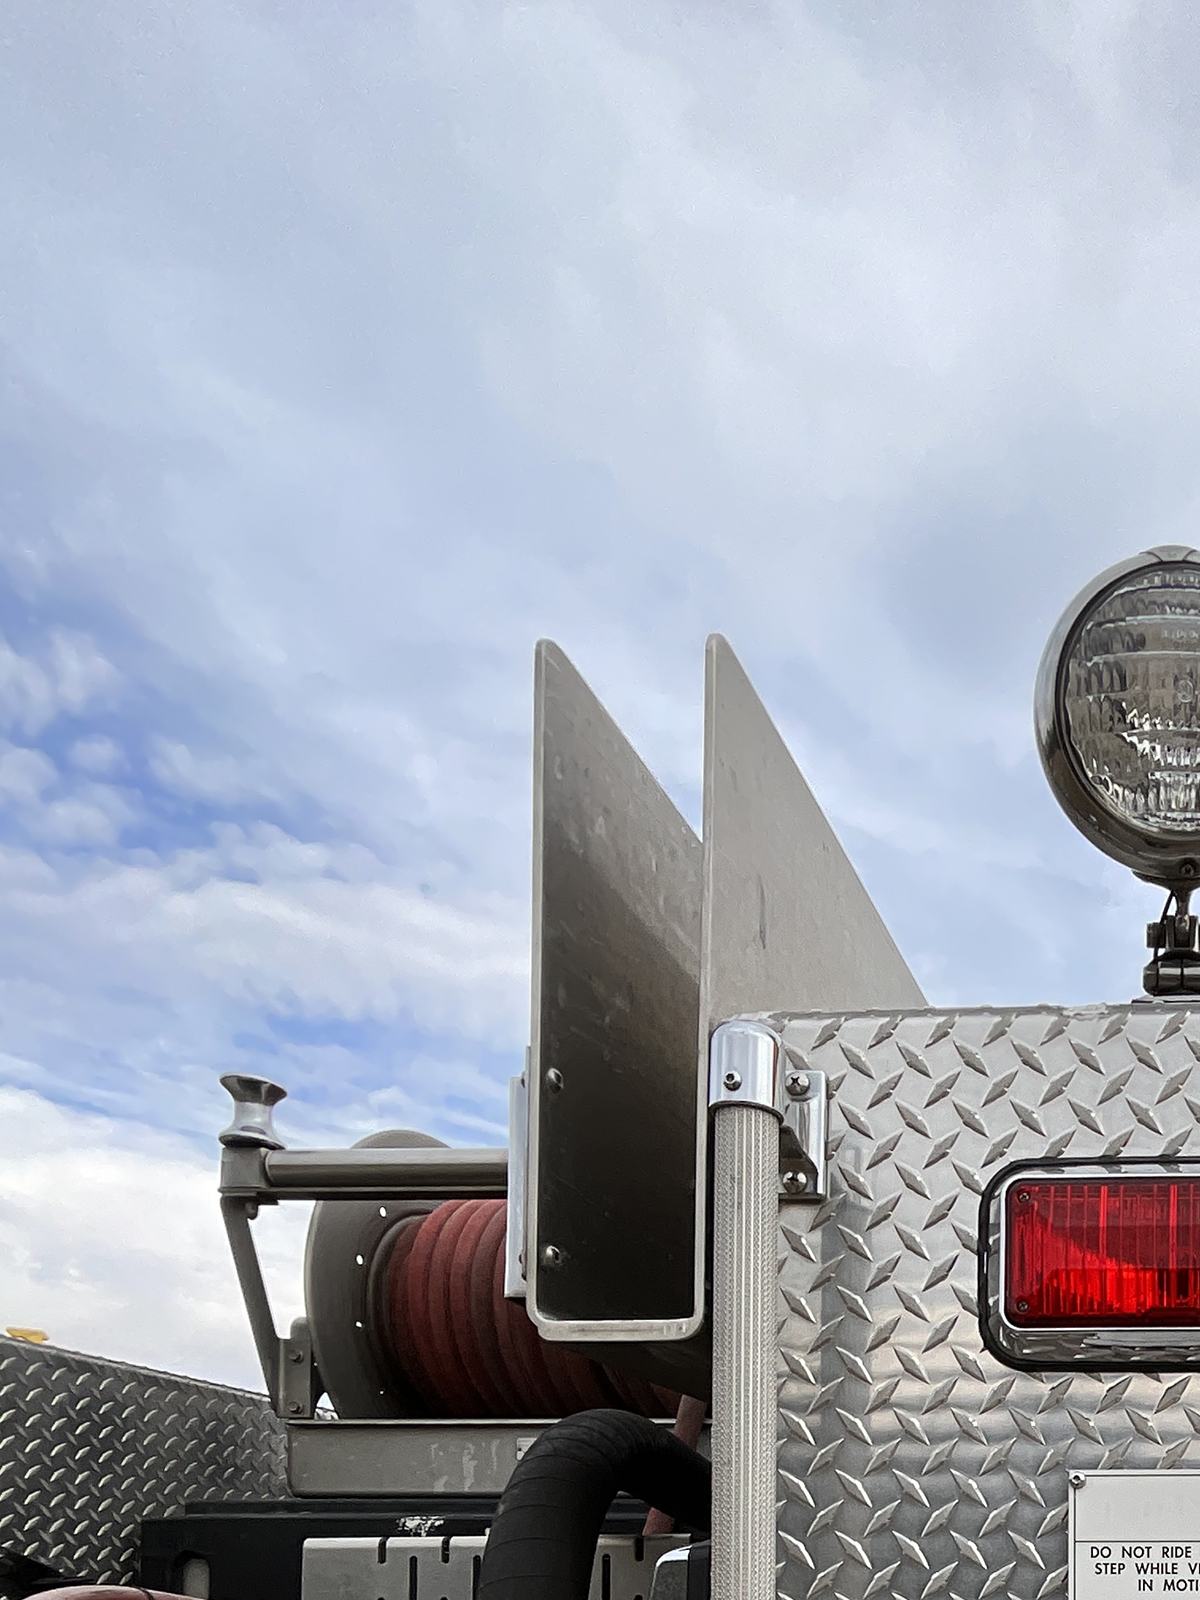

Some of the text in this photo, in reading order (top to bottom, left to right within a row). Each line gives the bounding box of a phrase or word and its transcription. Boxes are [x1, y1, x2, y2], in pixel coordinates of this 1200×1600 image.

[1090, 1546, 1112, 1558] DO
[1122, 1546, 1152, 1558] NOT
[1162, 1546, 1191, 1558] RIDE
[1094, 1563, 1126, 1575] STEP
[1135, 1563, 1178, 1575] WHILE
[1138, 1579, 1153, 1591] IN
